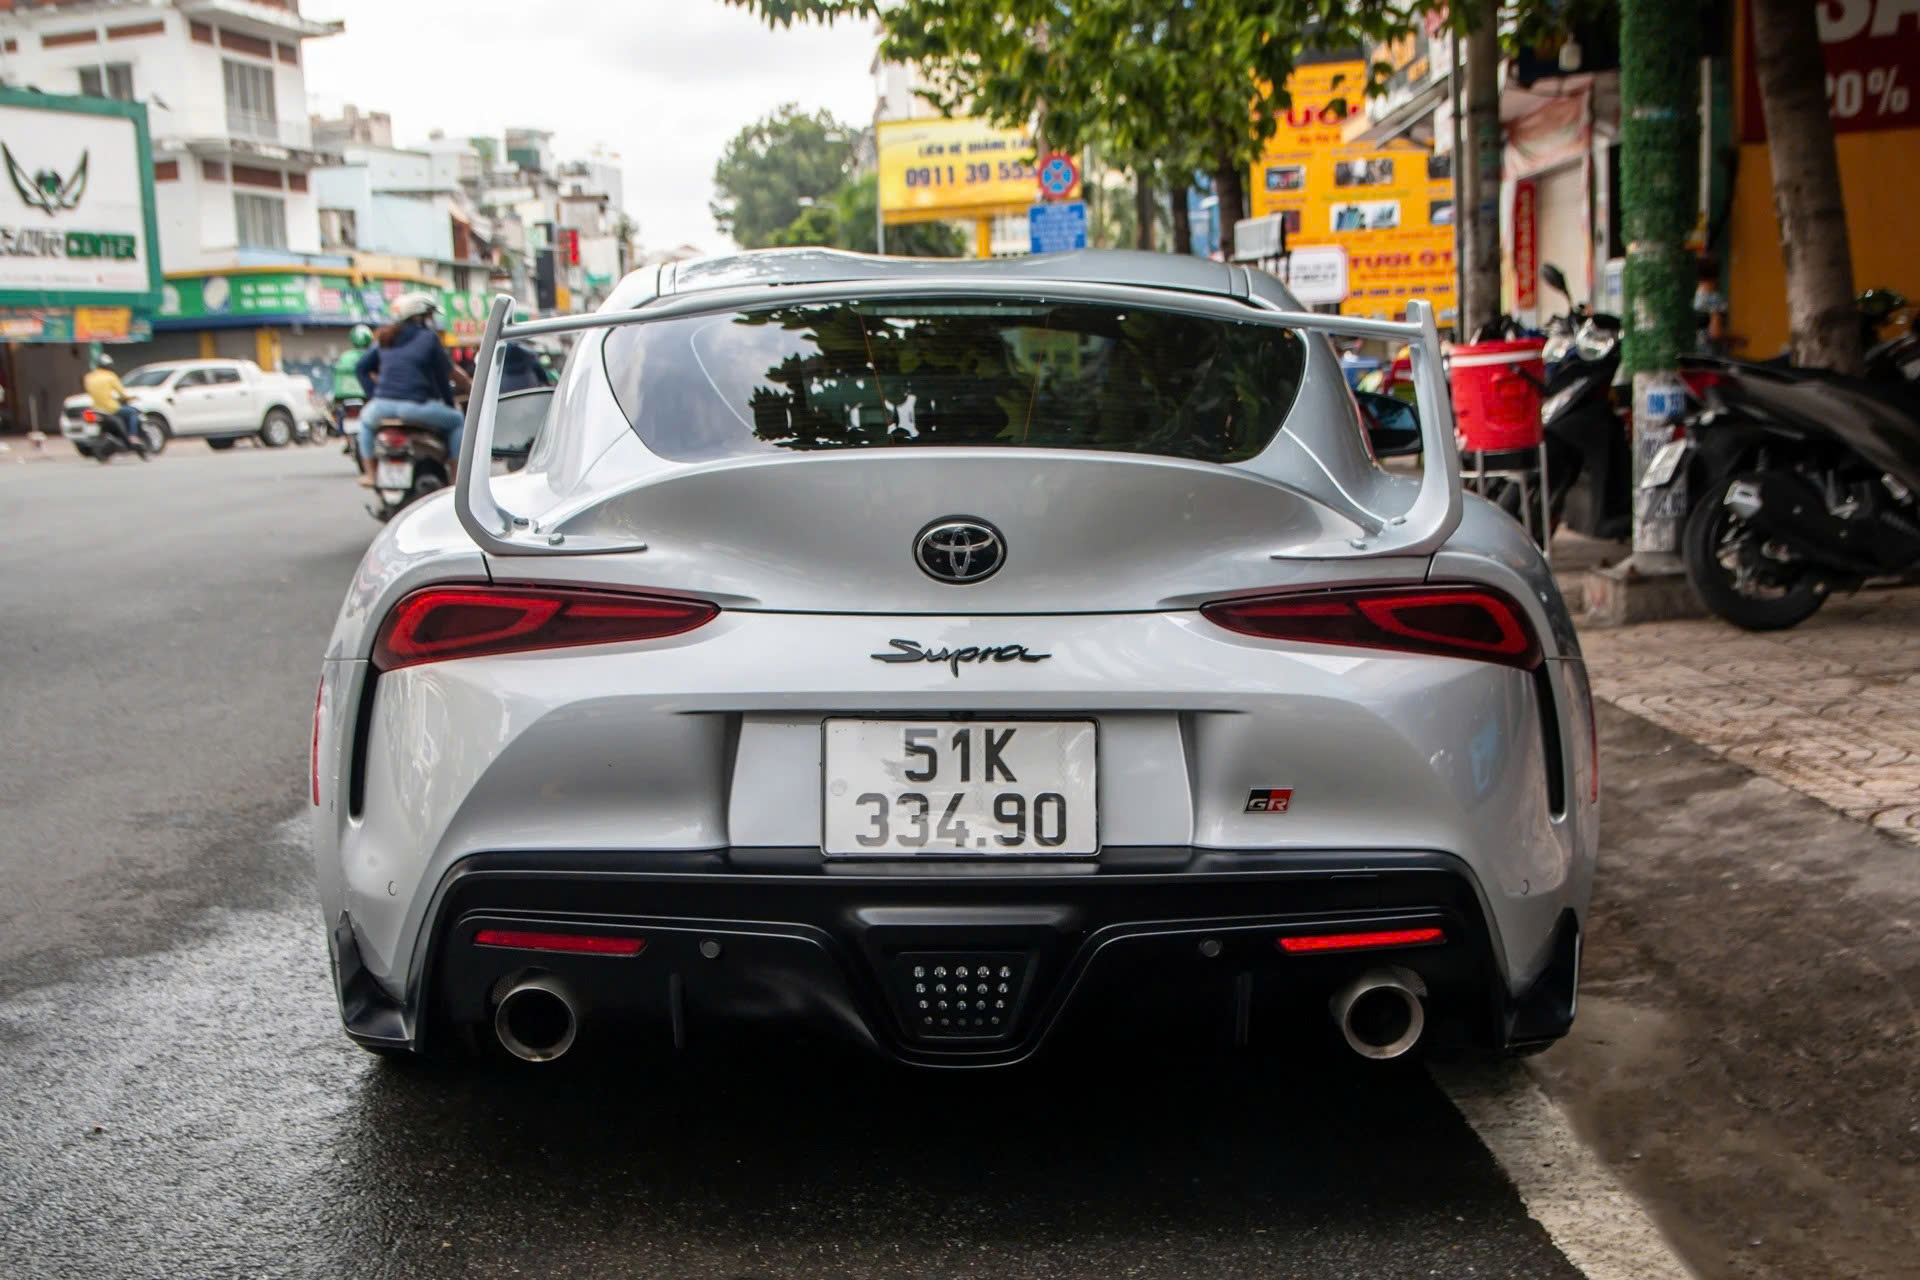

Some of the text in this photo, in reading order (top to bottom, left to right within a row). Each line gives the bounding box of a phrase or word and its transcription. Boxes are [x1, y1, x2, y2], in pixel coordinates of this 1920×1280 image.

[905, 166, 955, 188] 0911
[966, 162, 990, 184] 39
[870, 638, 1052, 678] Supra
[904, 728, 1018, 783] 51K
[855, 792, 1067, 847] 334.90
[1247, 798, 1290, 811] GR
